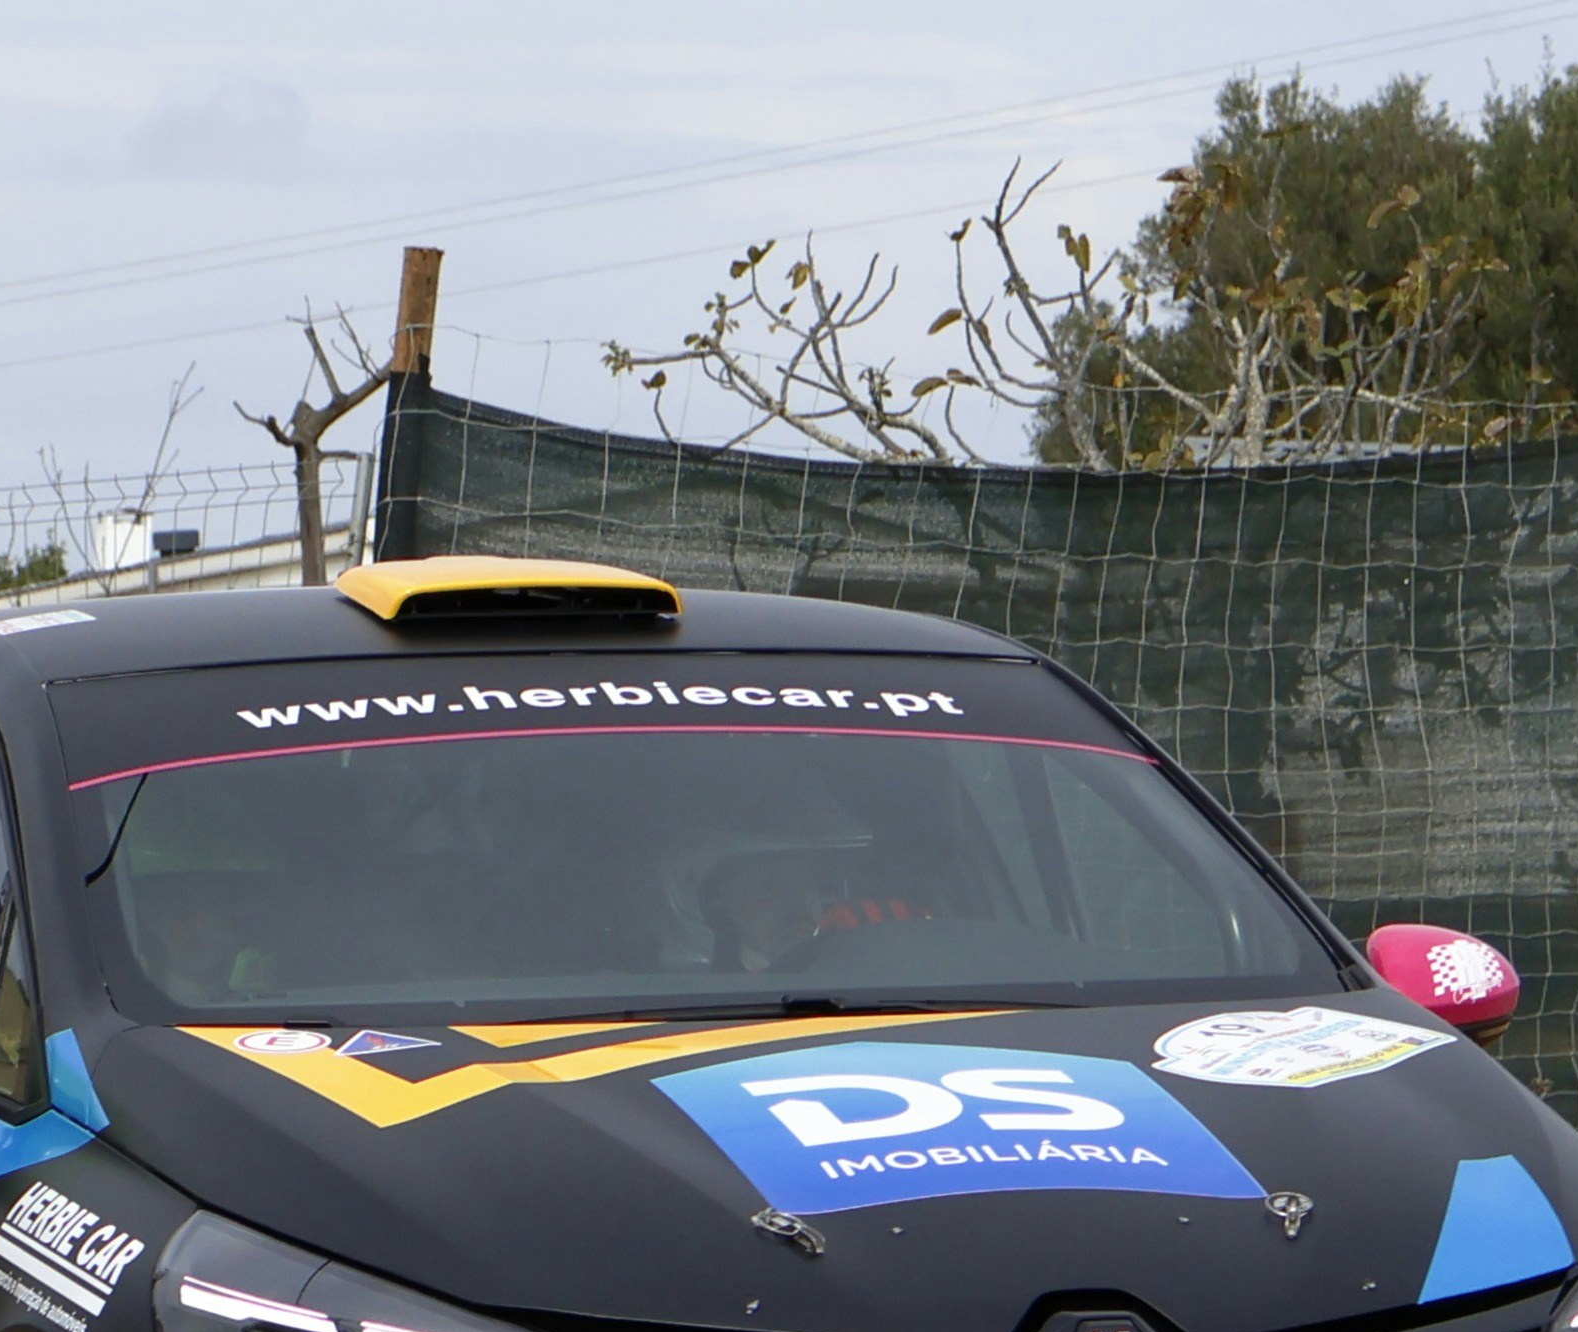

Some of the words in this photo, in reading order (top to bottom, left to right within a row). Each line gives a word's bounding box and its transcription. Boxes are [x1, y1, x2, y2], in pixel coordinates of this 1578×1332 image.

[236, 682, 965, 728] www.herbiecar.pt
[740, 1068, 1125, 1147] DS
[819, 1140, 1169, 1180] IMOBILIÁRIA
[5, 1181, 100, 1257] HERBIE
[75, 1224, 145, 1286] CAR
